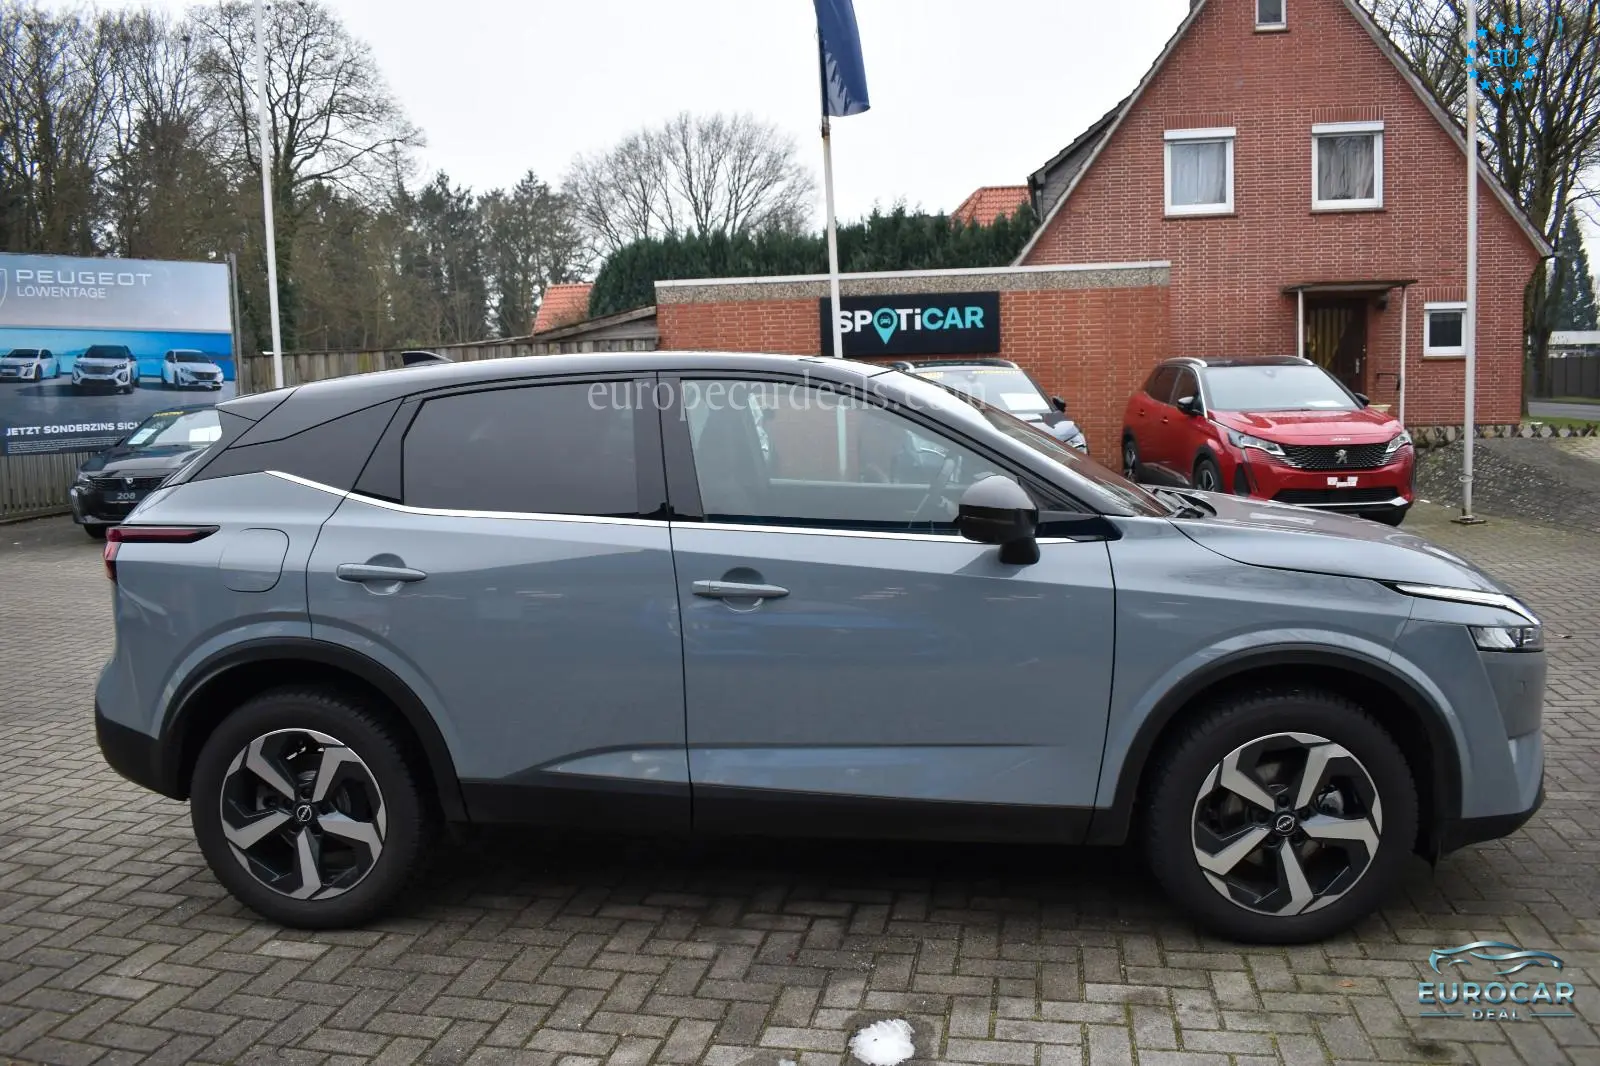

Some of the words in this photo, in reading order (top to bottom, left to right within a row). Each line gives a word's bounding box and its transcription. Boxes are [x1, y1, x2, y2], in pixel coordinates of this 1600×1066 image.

[15, 269, 152, 286] PEUGEOT
[6, 426, 41, 437] JETZT
[43, 422, 115, 434] SONDERZINS
[117, 492, 136, 500] 208
